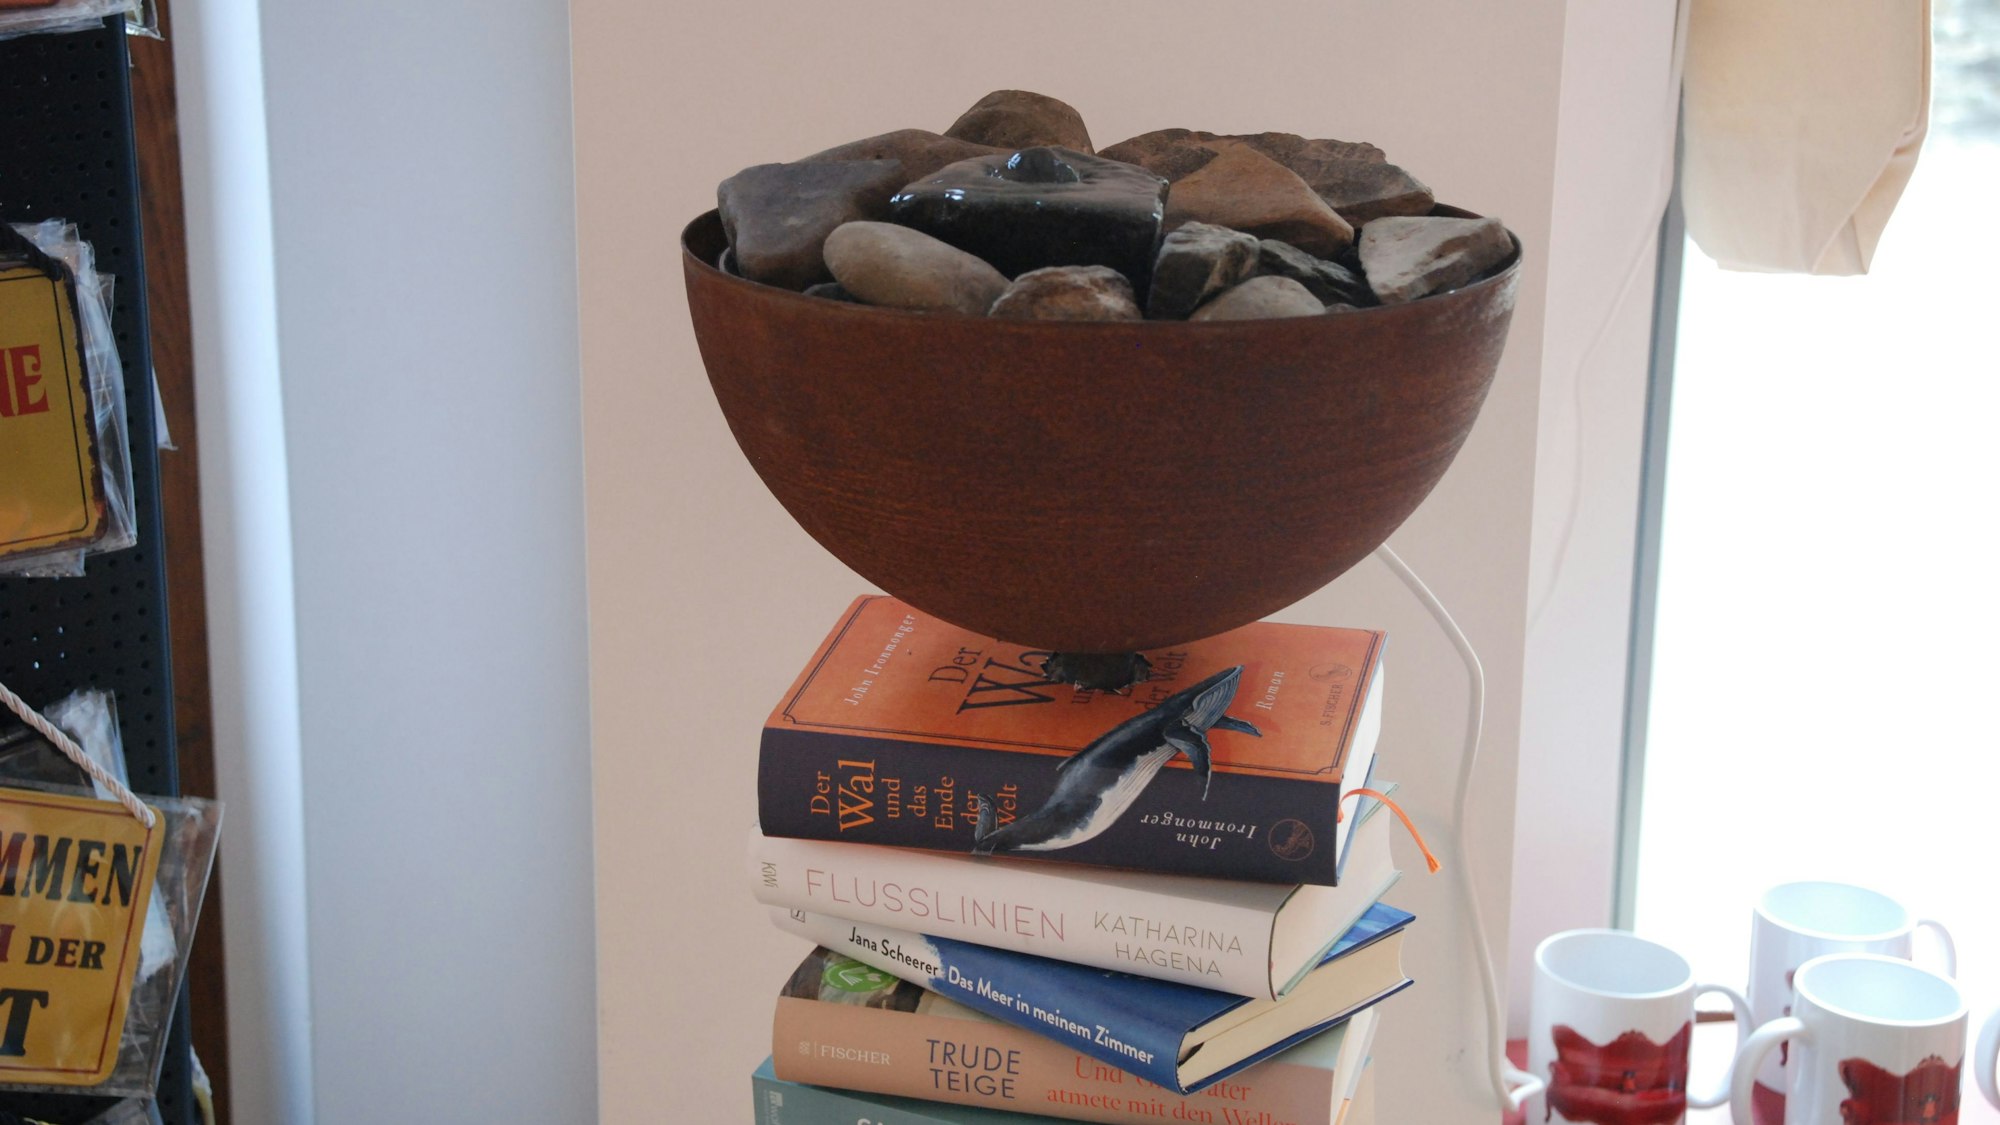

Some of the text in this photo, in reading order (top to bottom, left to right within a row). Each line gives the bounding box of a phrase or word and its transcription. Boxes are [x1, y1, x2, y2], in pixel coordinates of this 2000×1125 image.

[844, 614, 916, 706] John Ironmonger
[928, 646, 983, 685] Der
[1256, 671, 1286, 711] Roman
[810, 770, 831, 816] Der
[837, 759, 876, 832] Wal
[881, 777, 900, 819] und
[907, 785, 927, 818] das
[934, 776, 954, 830] Ende
[960, 790, 981, 826] der
[996, 783, 1018, 826] Welt
[1140, 811, 1257, 840] Ironmonger
[1176, 832, 1222, 850] John
[806, 868, 1066, 942] FLUSSLINIEN
[25, 936, 106, 970] DER
[1094, 911, 1243, 956] KATHARINA
[1115, 942, 1222, 977] HAGENA
[848, 926, 1154, 1064] Jana Scheerer Das Meer in meinem Zimmer
[820, 1045, 891, 1066] FISCHER
[926, 1039, 1021, 1075] TRUDE
[929, 1068, 1016, 1099] TEIGE
[1075, 1056, 1123, 1084] Und
[1199, 1080, 1251, 1101] ater
[1047, 1088, 1122, 1111] atmete
[1128, 1098, 1166, 1117] mit
[1172, 1101, 1214, 1124] den
